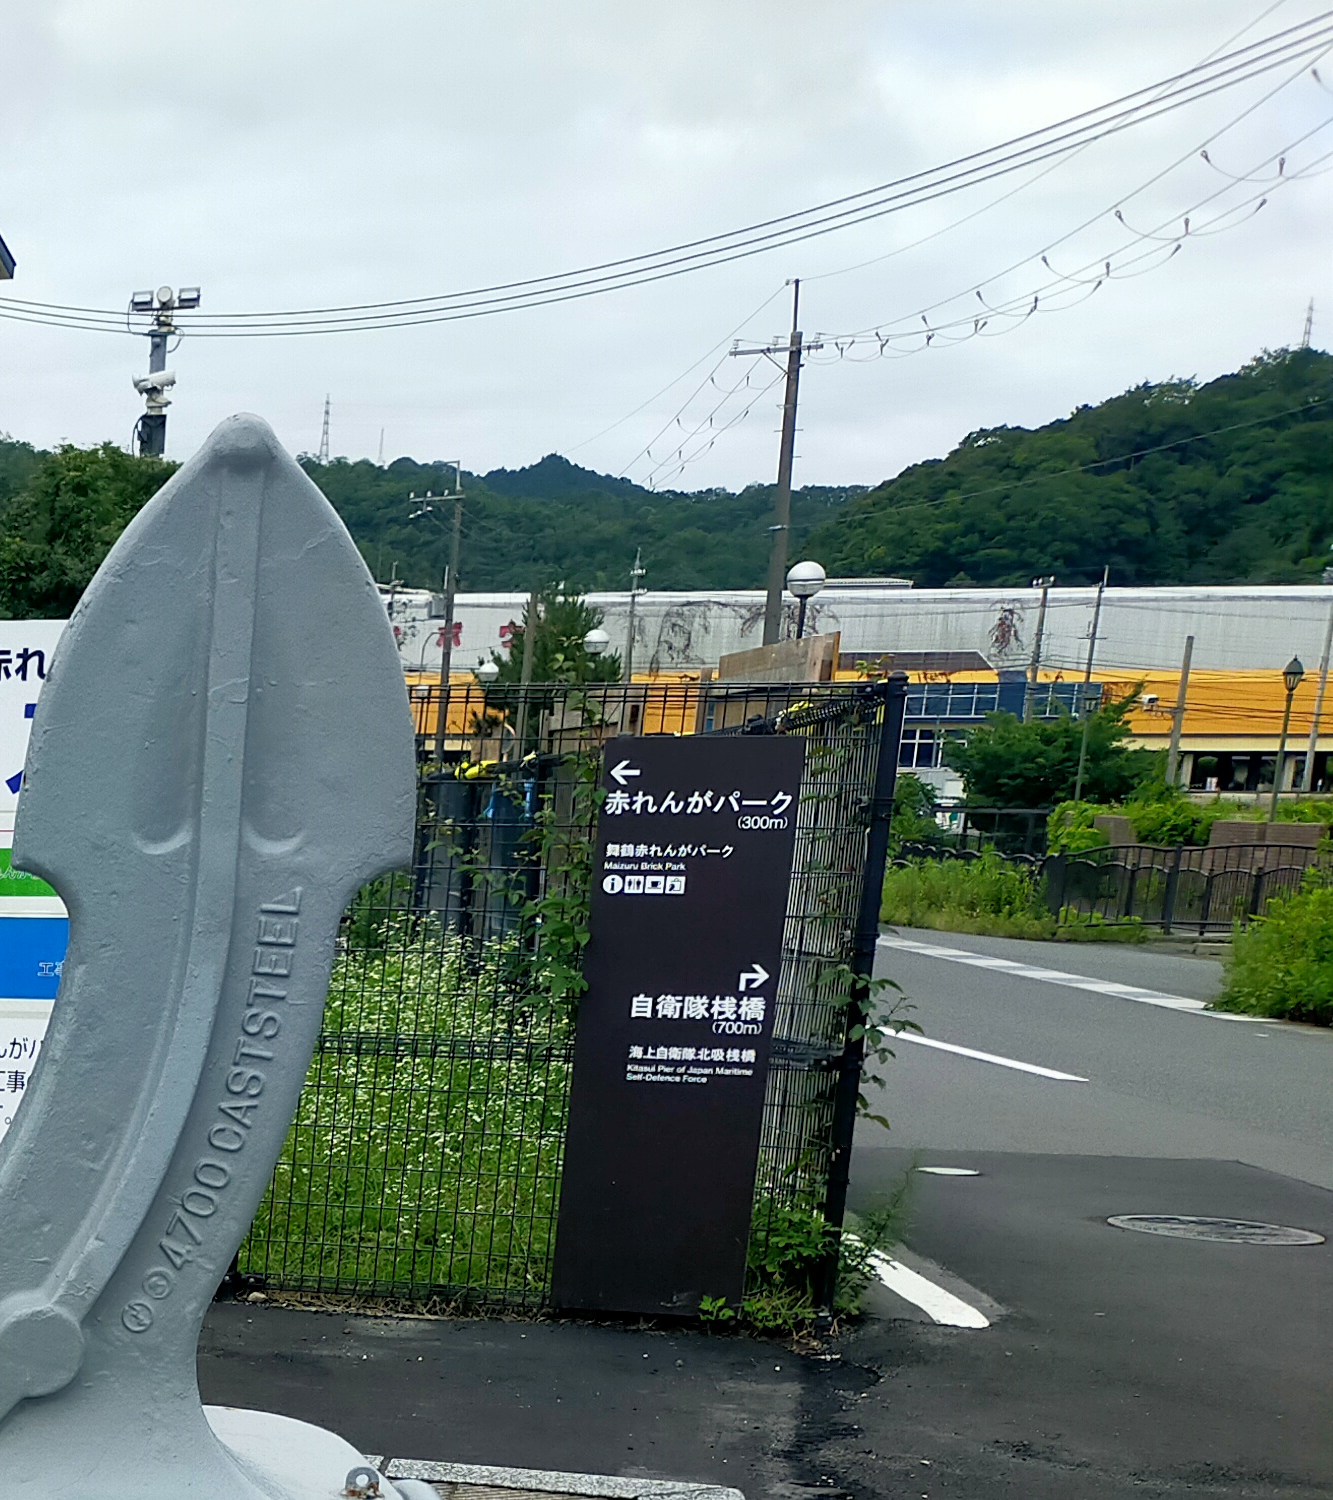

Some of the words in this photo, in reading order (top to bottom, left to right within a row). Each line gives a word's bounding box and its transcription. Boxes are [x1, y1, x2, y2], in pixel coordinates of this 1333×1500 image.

[604, 790, 793, 815] 赤れんがパーク
[737, 816, 788, 830] (300m)
[606, 843, 733, 858] 舞鶴赤れんがパーク
[604, 862, 638, 870] Maizuru
[640, 862, 664, 871] Brick
[665, 862, 686, 871] Park
[631, 994, 766, 1021] 自衛隊桟橋
[712, 1021, 763, 1035] (700m)
[628, 1045, 757, 1063] 海上自衛隊北吸桟橋
[657, 1065, 675, 1073] Pier
[676, 1066, 686, 1074] of
[687, 1066, 714, 1075] Japan
[715, 1067, 754, 1076] Maritime
[682, 1075, 708, 1083] Force
